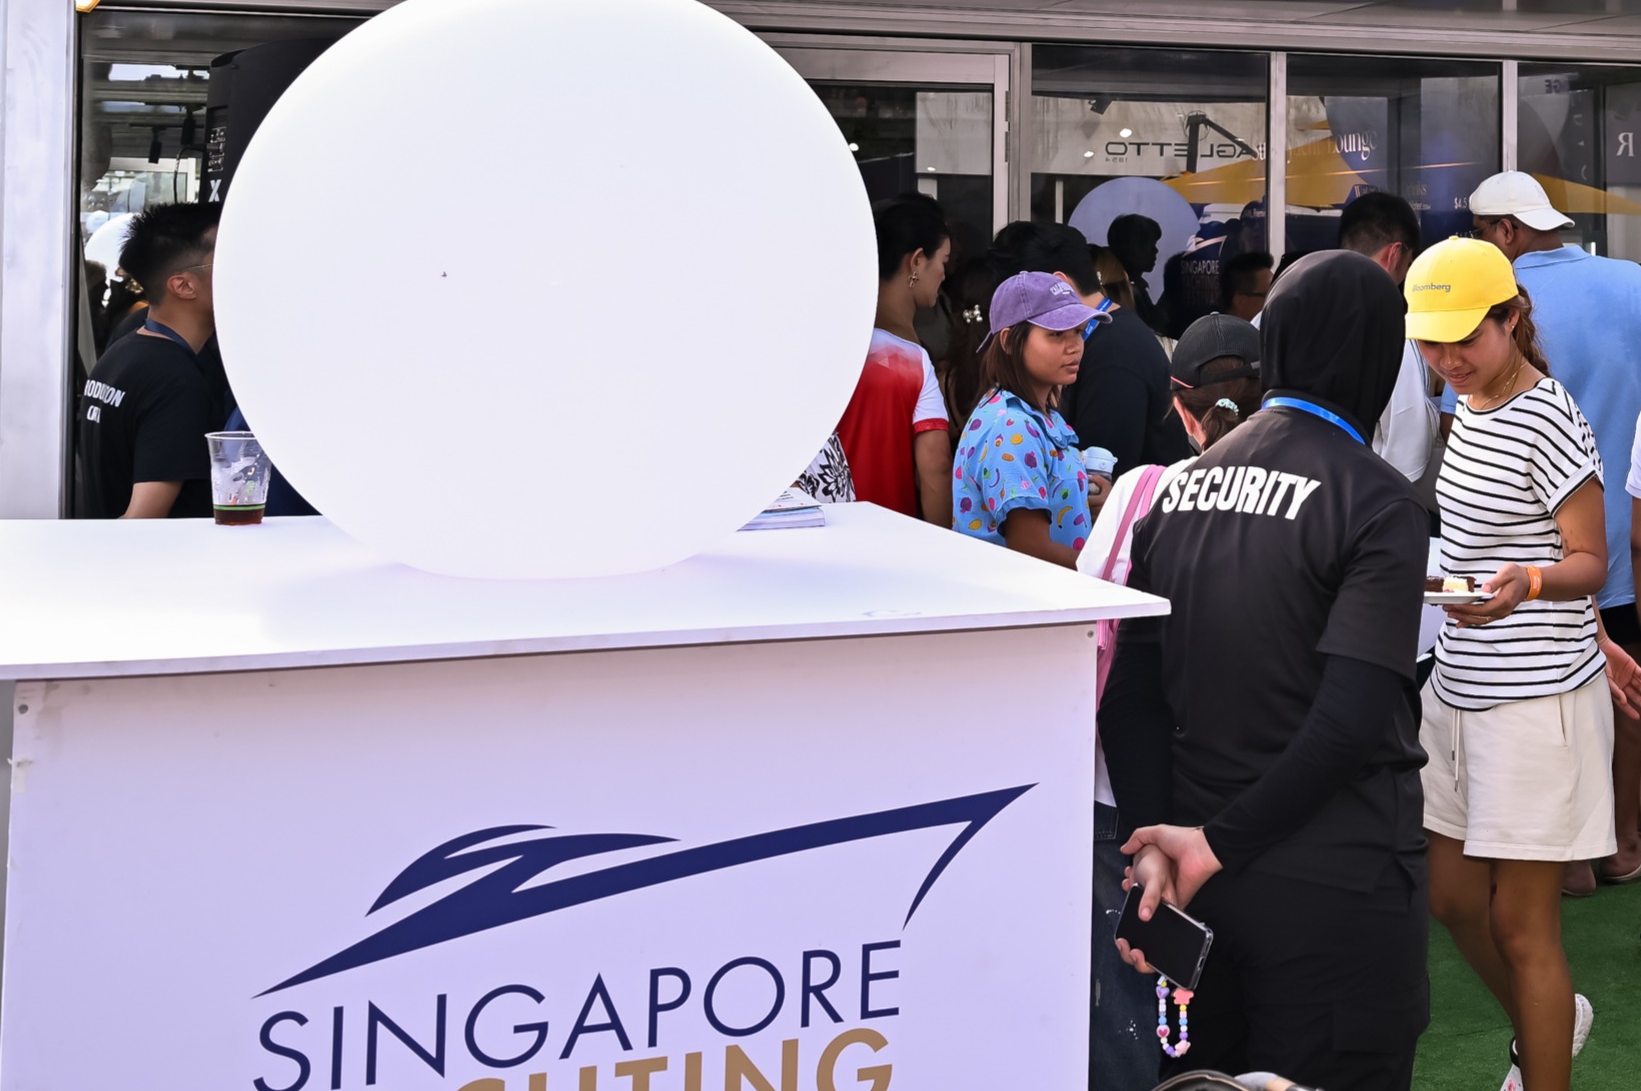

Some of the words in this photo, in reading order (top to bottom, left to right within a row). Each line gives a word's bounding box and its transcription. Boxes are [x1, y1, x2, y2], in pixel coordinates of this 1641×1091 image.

[1180, 260, 1220, 275] SINGAPORE
[1161, 466, 1322, 520] SECURITY
[252, 939, 902, 1091] SINGAPORE
